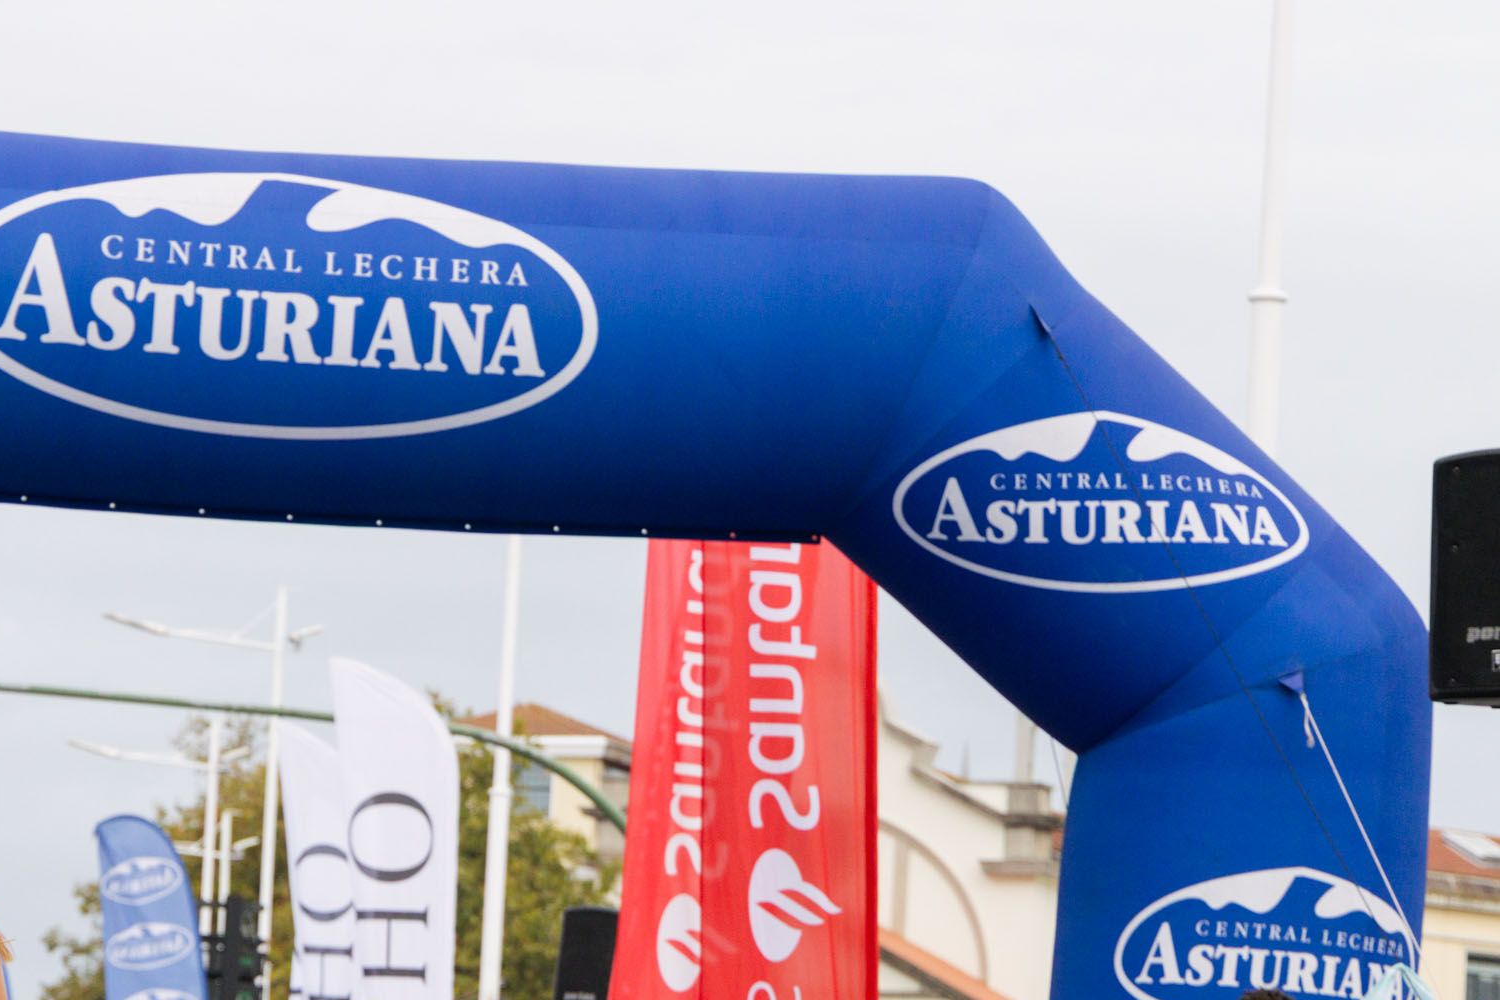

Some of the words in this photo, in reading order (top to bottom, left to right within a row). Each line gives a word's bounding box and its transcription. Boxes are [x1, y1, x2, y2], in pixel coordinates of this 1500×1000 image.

[100, 234, 302, 274] CENTRAL
[324, 251, 530, 288] LECHERA
[990, 472, 1129, 491] CENTRAL
[1141, 473, 1264, 500] LECHERA
[926, 476, 1289, 548] ASTURIANA
[1194, 919, 1313, 945] CENTRAL
